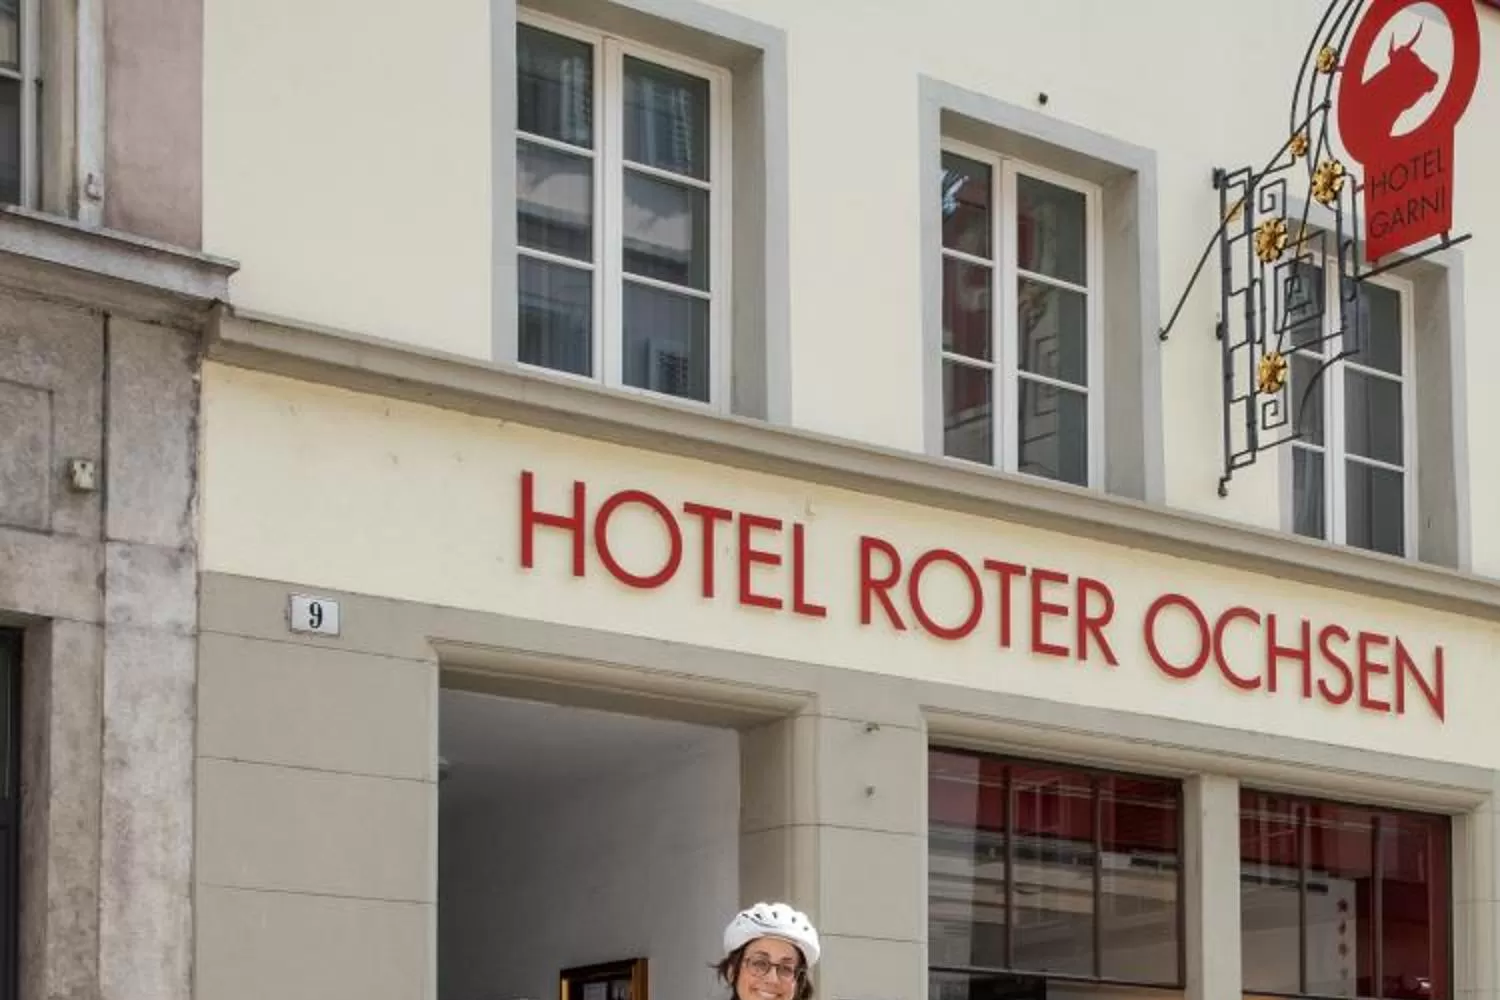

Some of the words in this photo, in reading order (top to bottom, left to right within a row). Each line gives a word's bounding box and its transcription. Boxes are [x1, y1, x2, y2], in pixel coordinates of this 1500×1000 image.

[1371, 145, 1444, 202] HOTEL
[1370, 185, 1445, 239] GARNI
[309, 601, 323, 629] 9
[520, 469, 827, 618] HOTEL
[860, 535, 1119, 667] ROTER
[1144, 593, 1446, 724] OCHSEN
